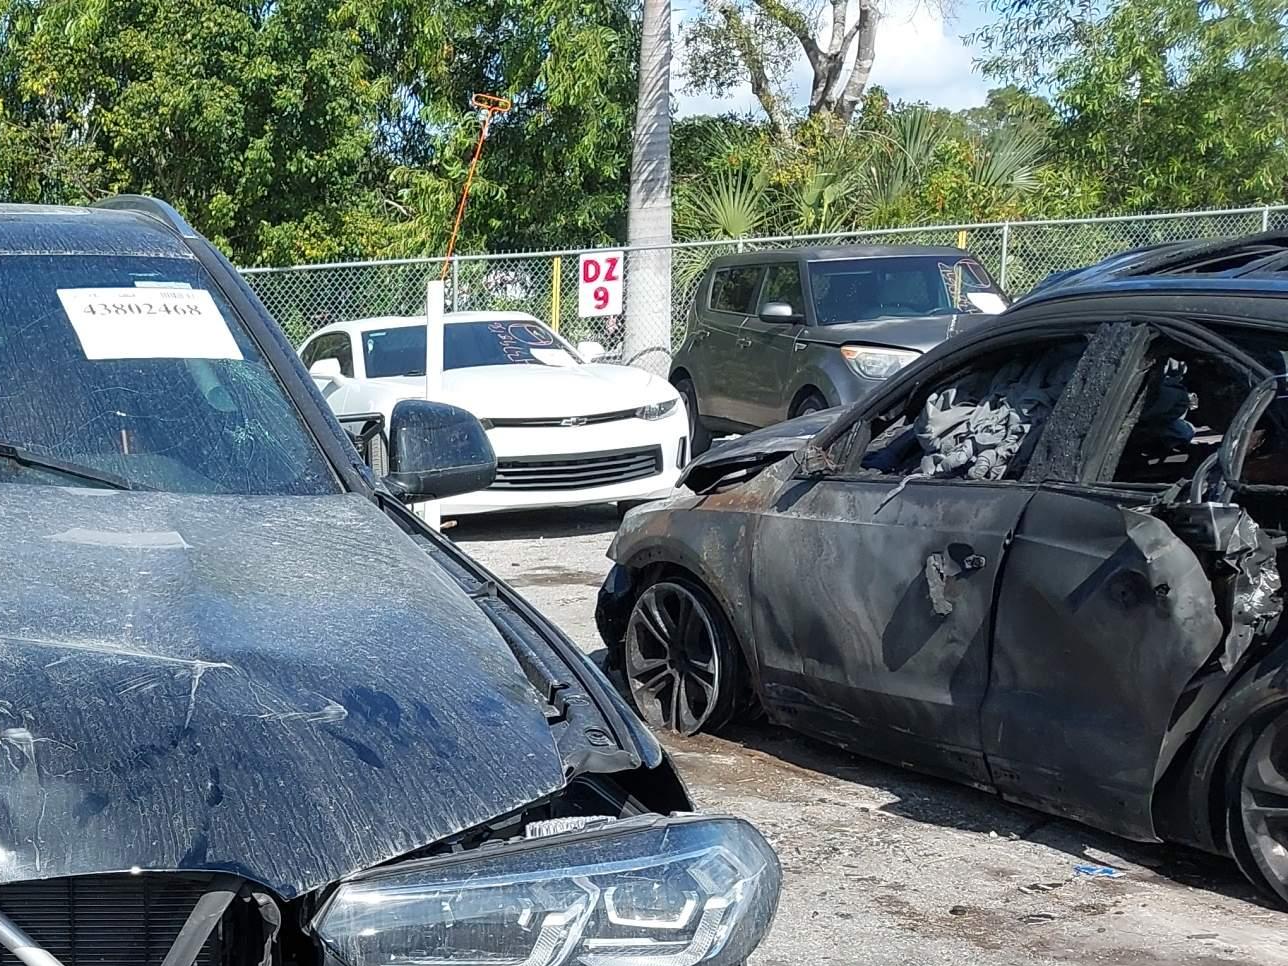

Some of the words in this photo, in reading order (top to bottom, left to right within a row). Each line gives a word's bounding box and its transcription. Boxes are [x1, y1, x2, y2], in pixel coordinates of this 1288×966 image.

[583, 257, 620, 283] DZ
[83, 302, 203, 316] 43802468
[593, 286, 610, 310] 9
